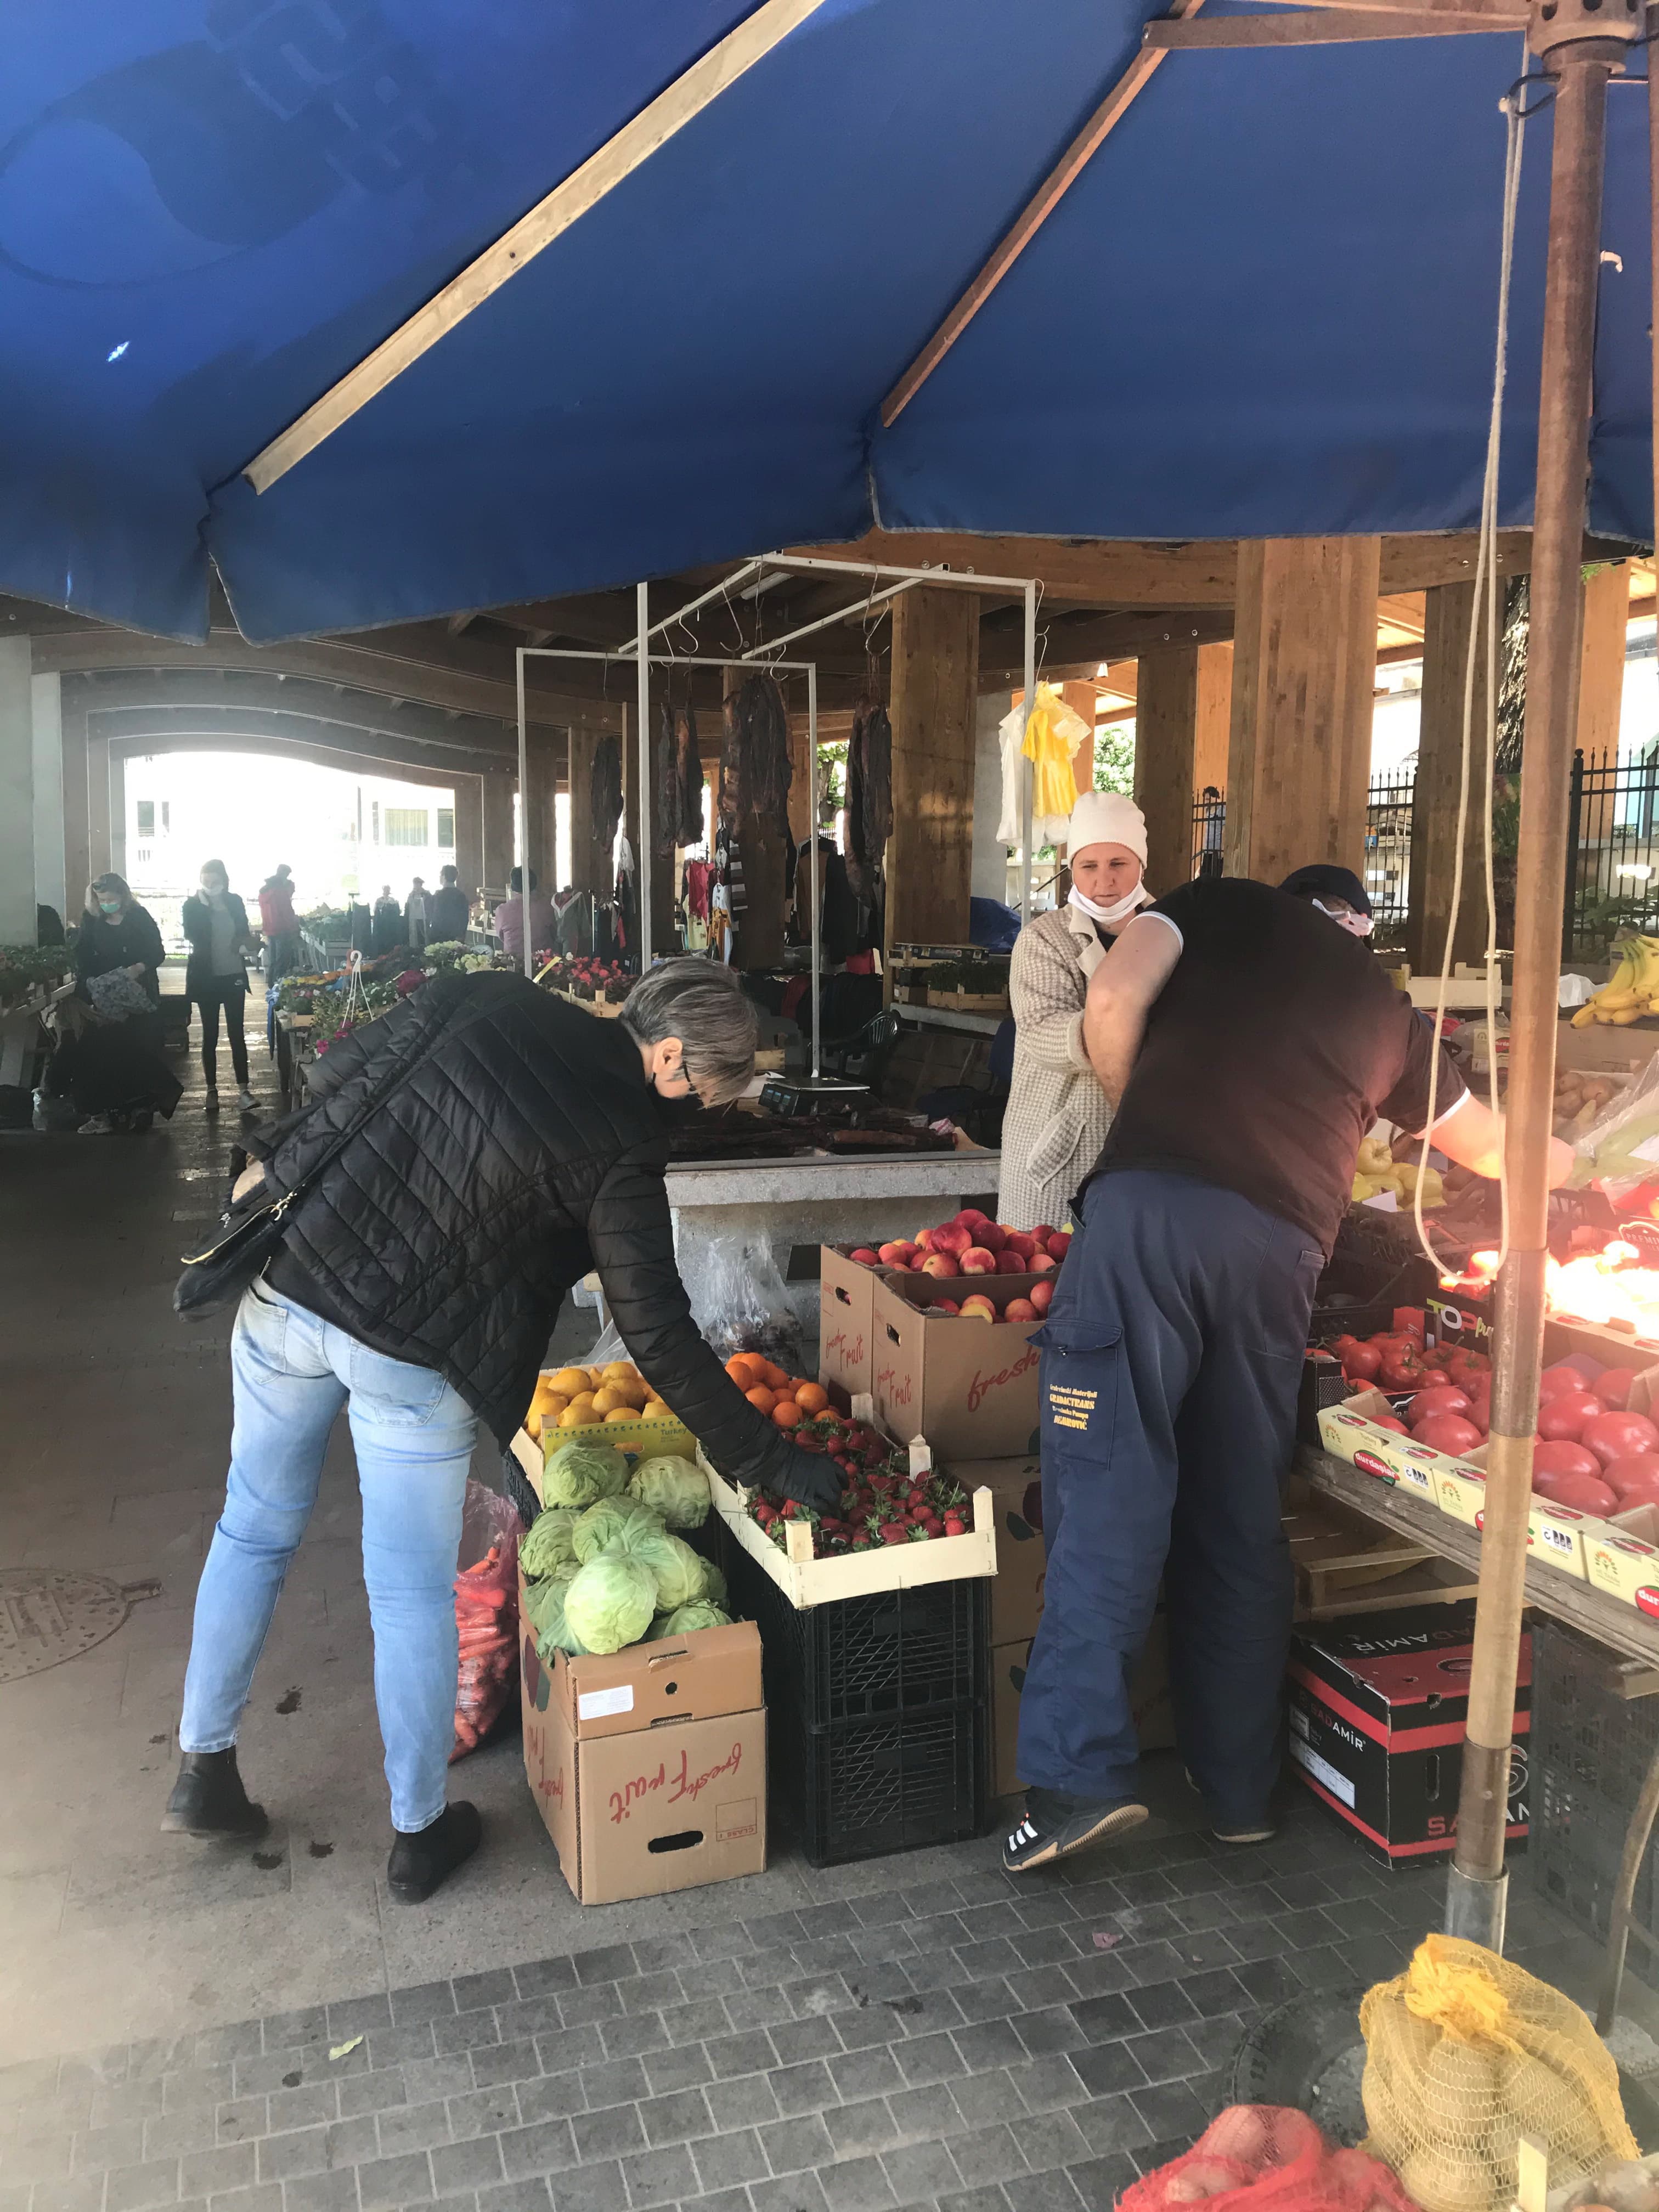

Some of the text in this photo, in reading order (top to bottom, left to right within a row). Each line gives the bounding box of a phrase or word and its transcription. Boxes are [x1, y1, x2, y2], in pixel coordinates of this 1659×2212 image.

[1426, 1298, 1477, 1332] TOP
[968, 1344, 1041, 1413] fresh
[610, 1742, 742, 1824] fresh Fruit
